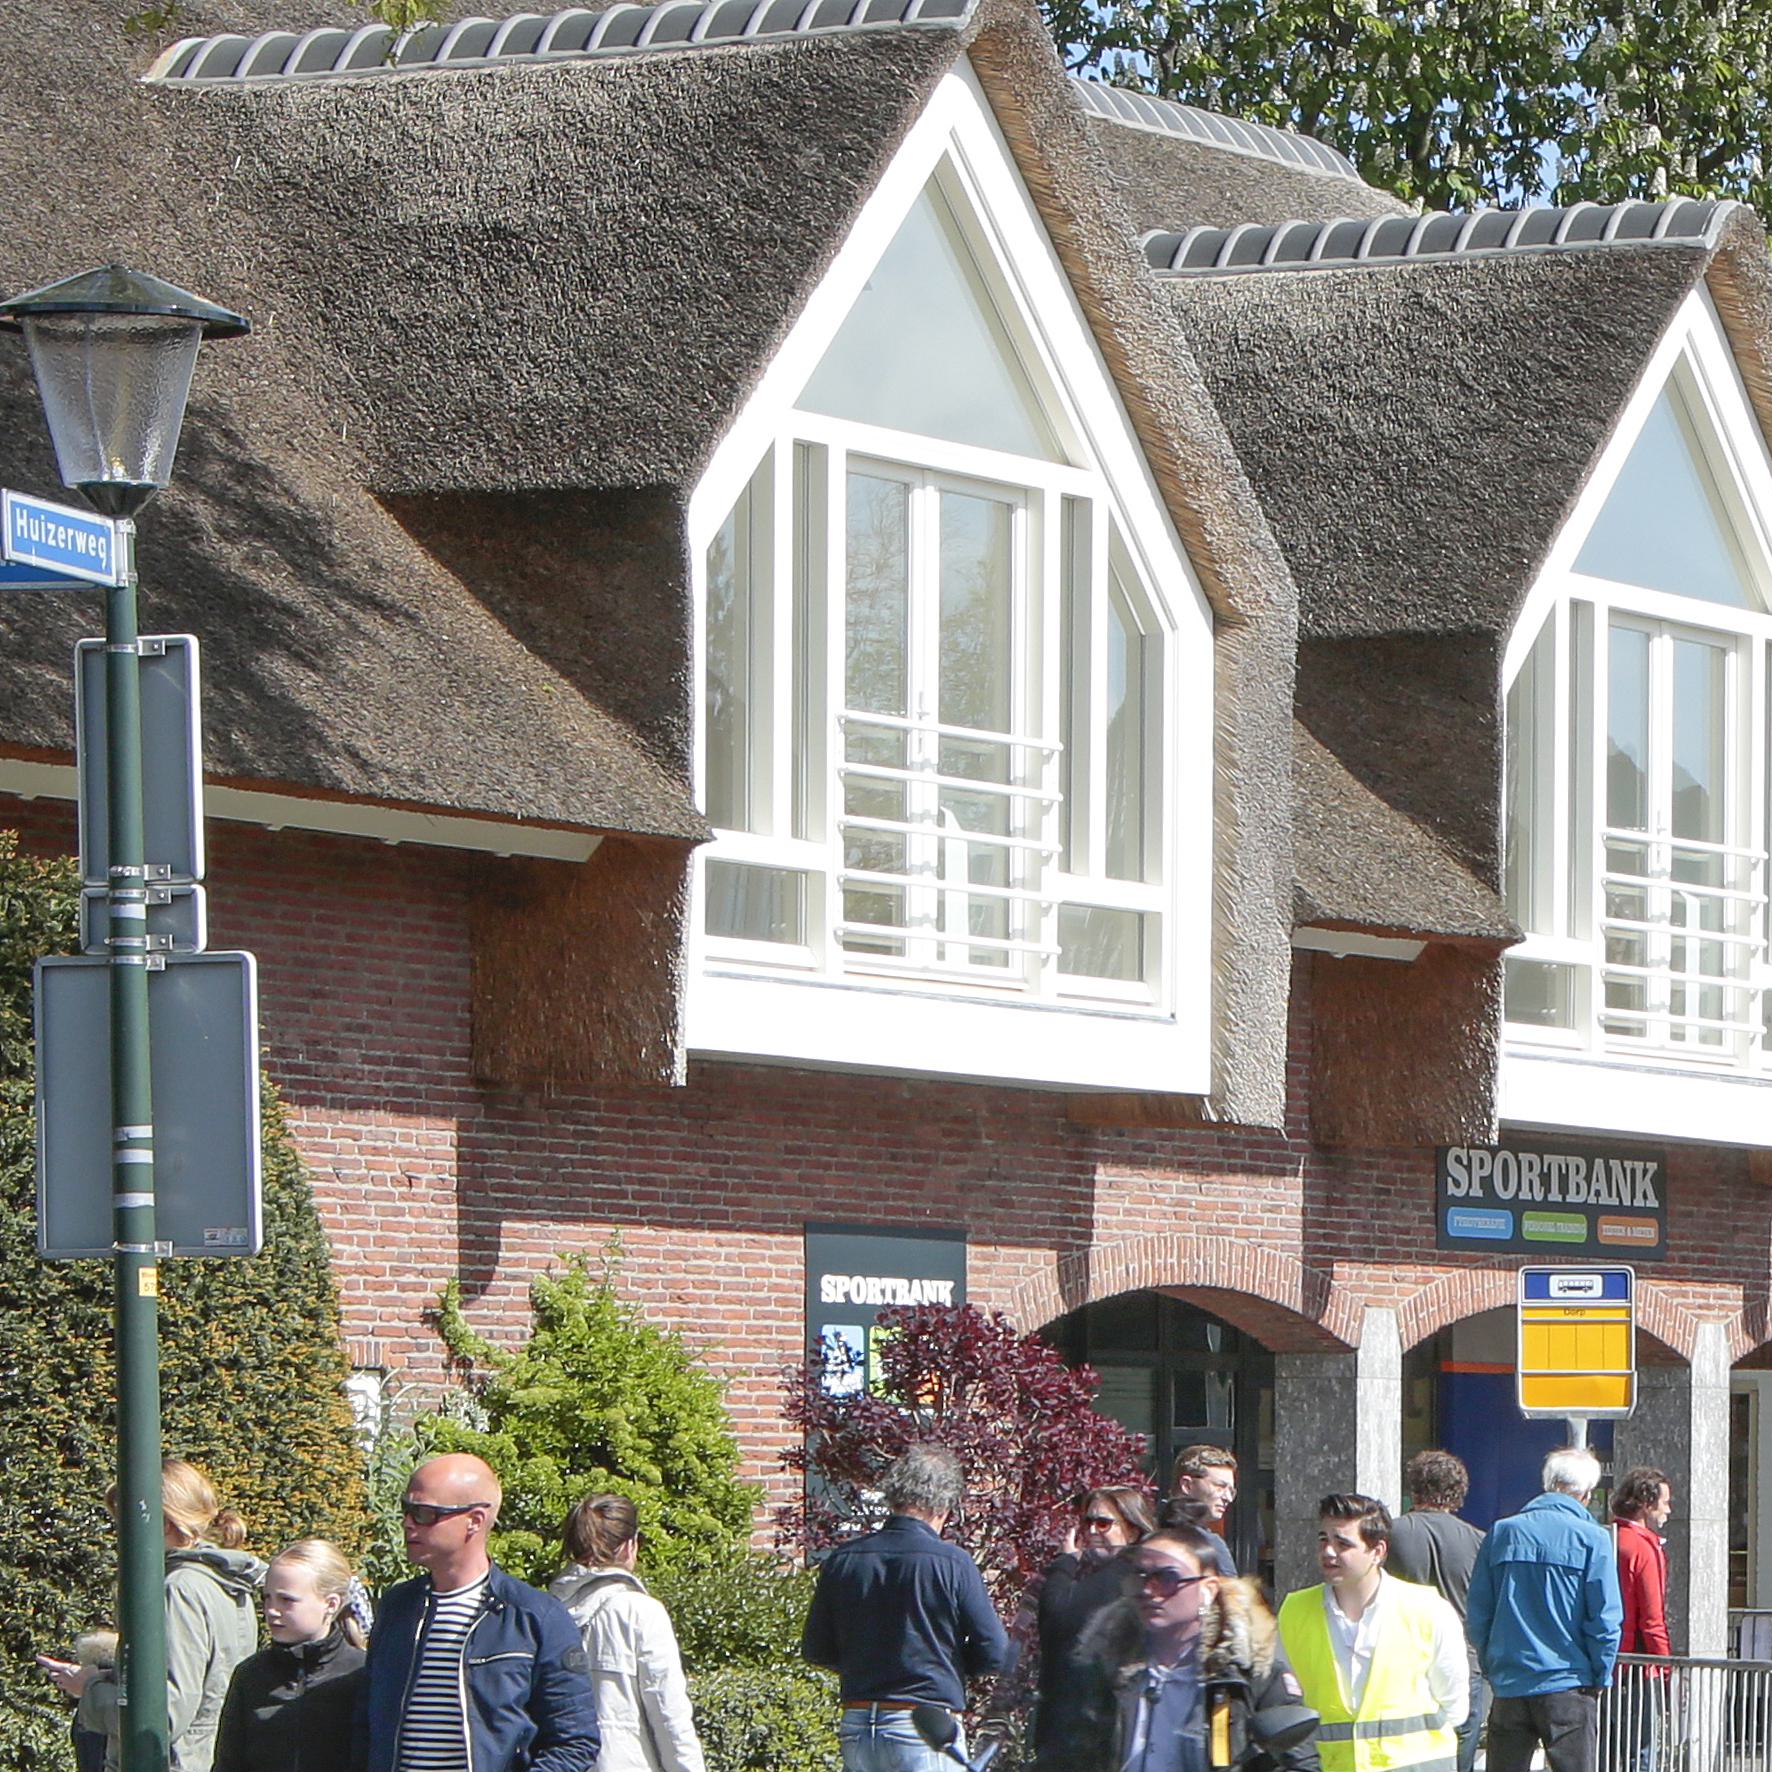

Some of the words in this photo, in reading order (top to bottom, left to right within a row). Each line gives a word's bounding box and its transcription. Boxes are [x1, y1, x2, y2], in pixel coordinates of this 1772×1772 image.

[15, 506, 108, 571] Huizerweg
[1446, 1146, 1660, 1209] SPORTBANK
[820, 1273, 955, 1308] SPORTBANK
